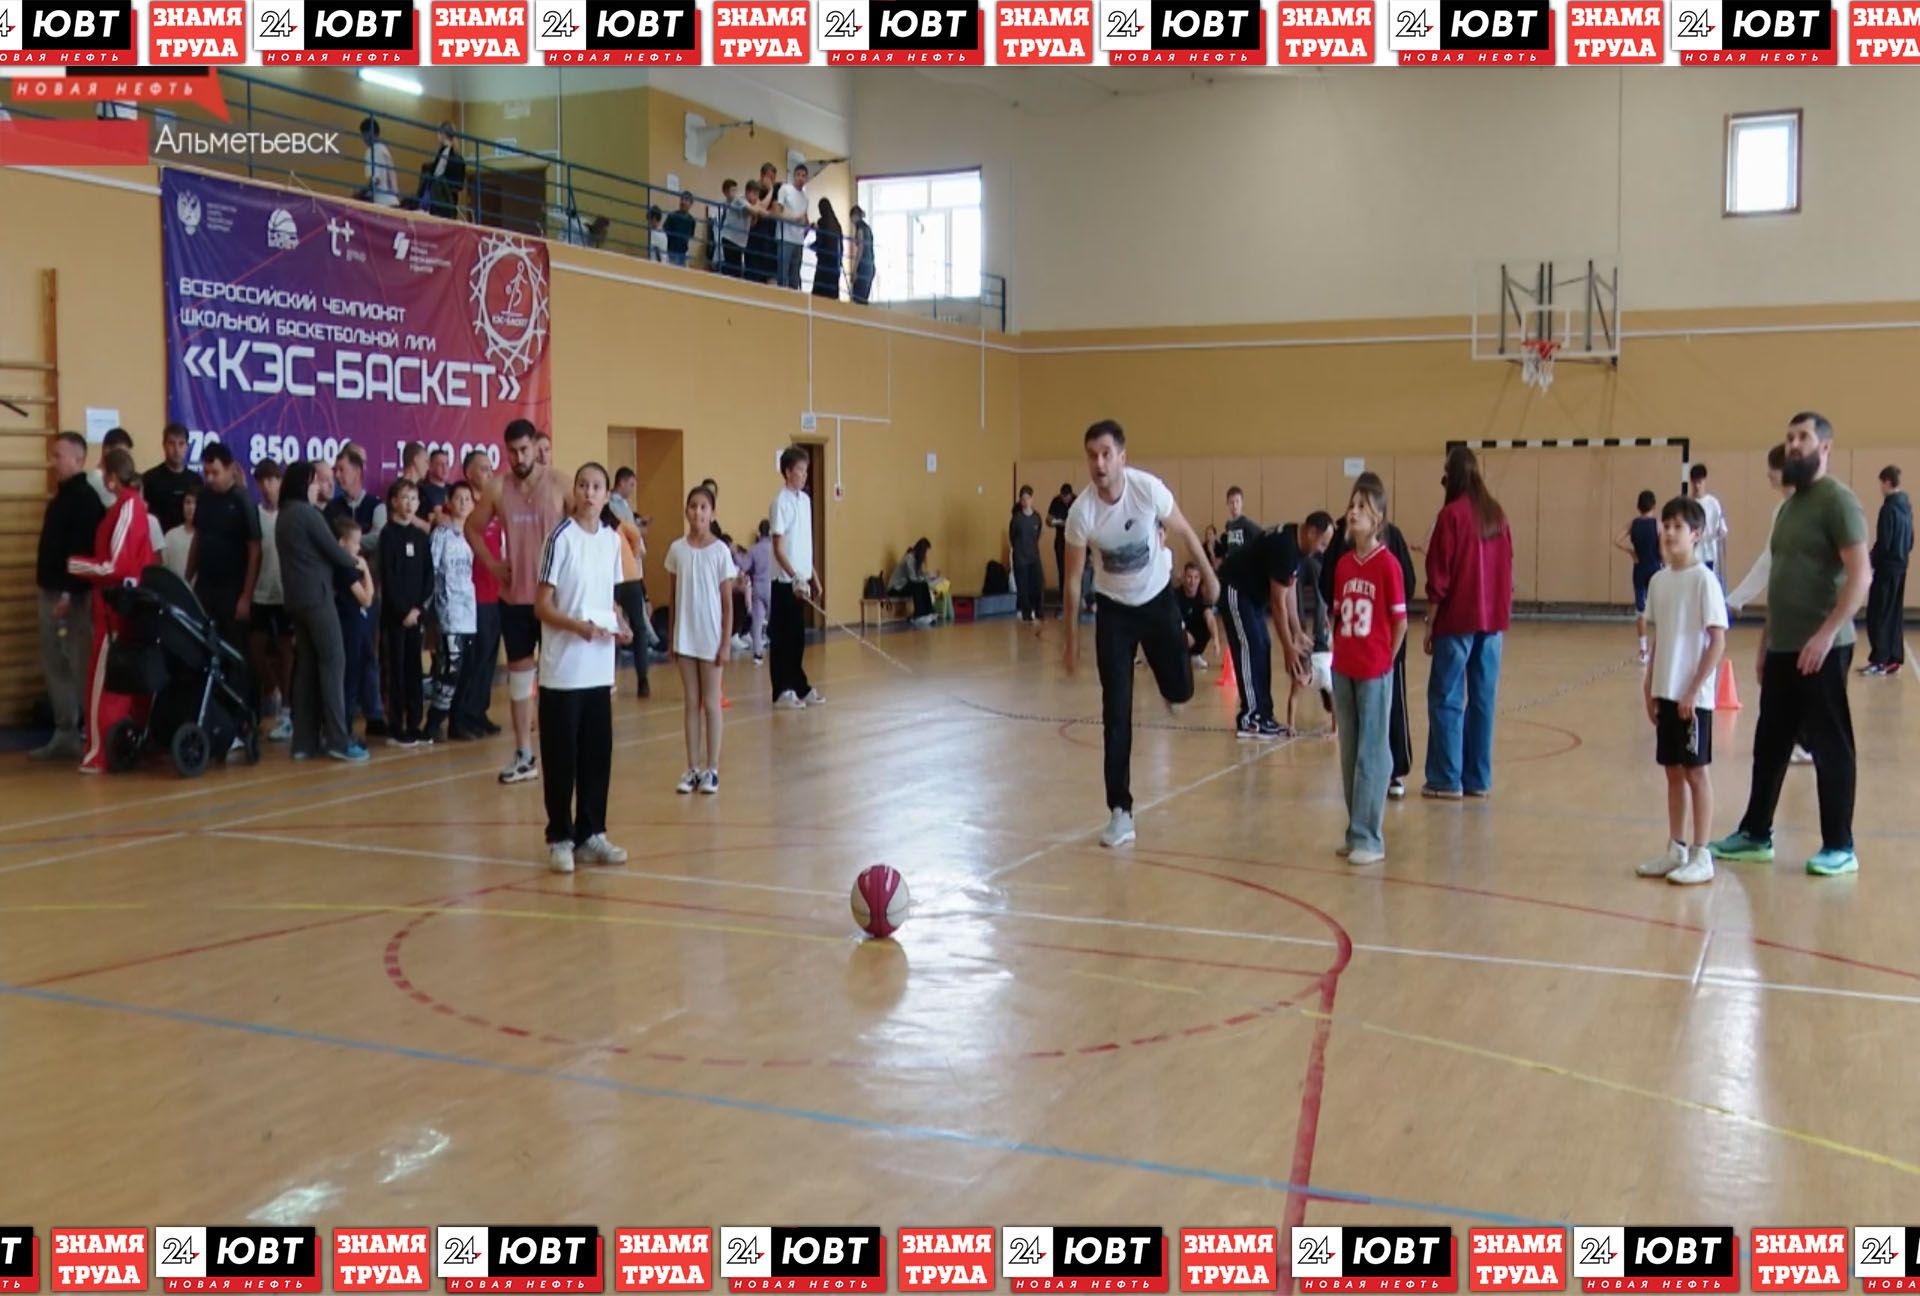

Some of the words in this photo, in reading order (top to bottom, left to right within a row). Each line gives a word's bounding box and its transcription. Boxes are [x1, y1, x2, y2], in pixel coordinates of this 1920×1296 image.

[179, 277, 317, 312] ВСЕРОССИЙСКИЙ
[321, 296, 406, 323] ЧЕМПИОНАТ
[180, 307, 270, 334] ШКОЛЬНОЙ
[276, 318, 399, 349] БАСКЕТБОЛЬНОЙ
[405, 334, 436, 352] ЛИГИ
[183, 338, 522, 408] «КЭС-БАСКЕТ»
[250, 434, 300, 466] 850
[307, 436, 350, 468] 00
